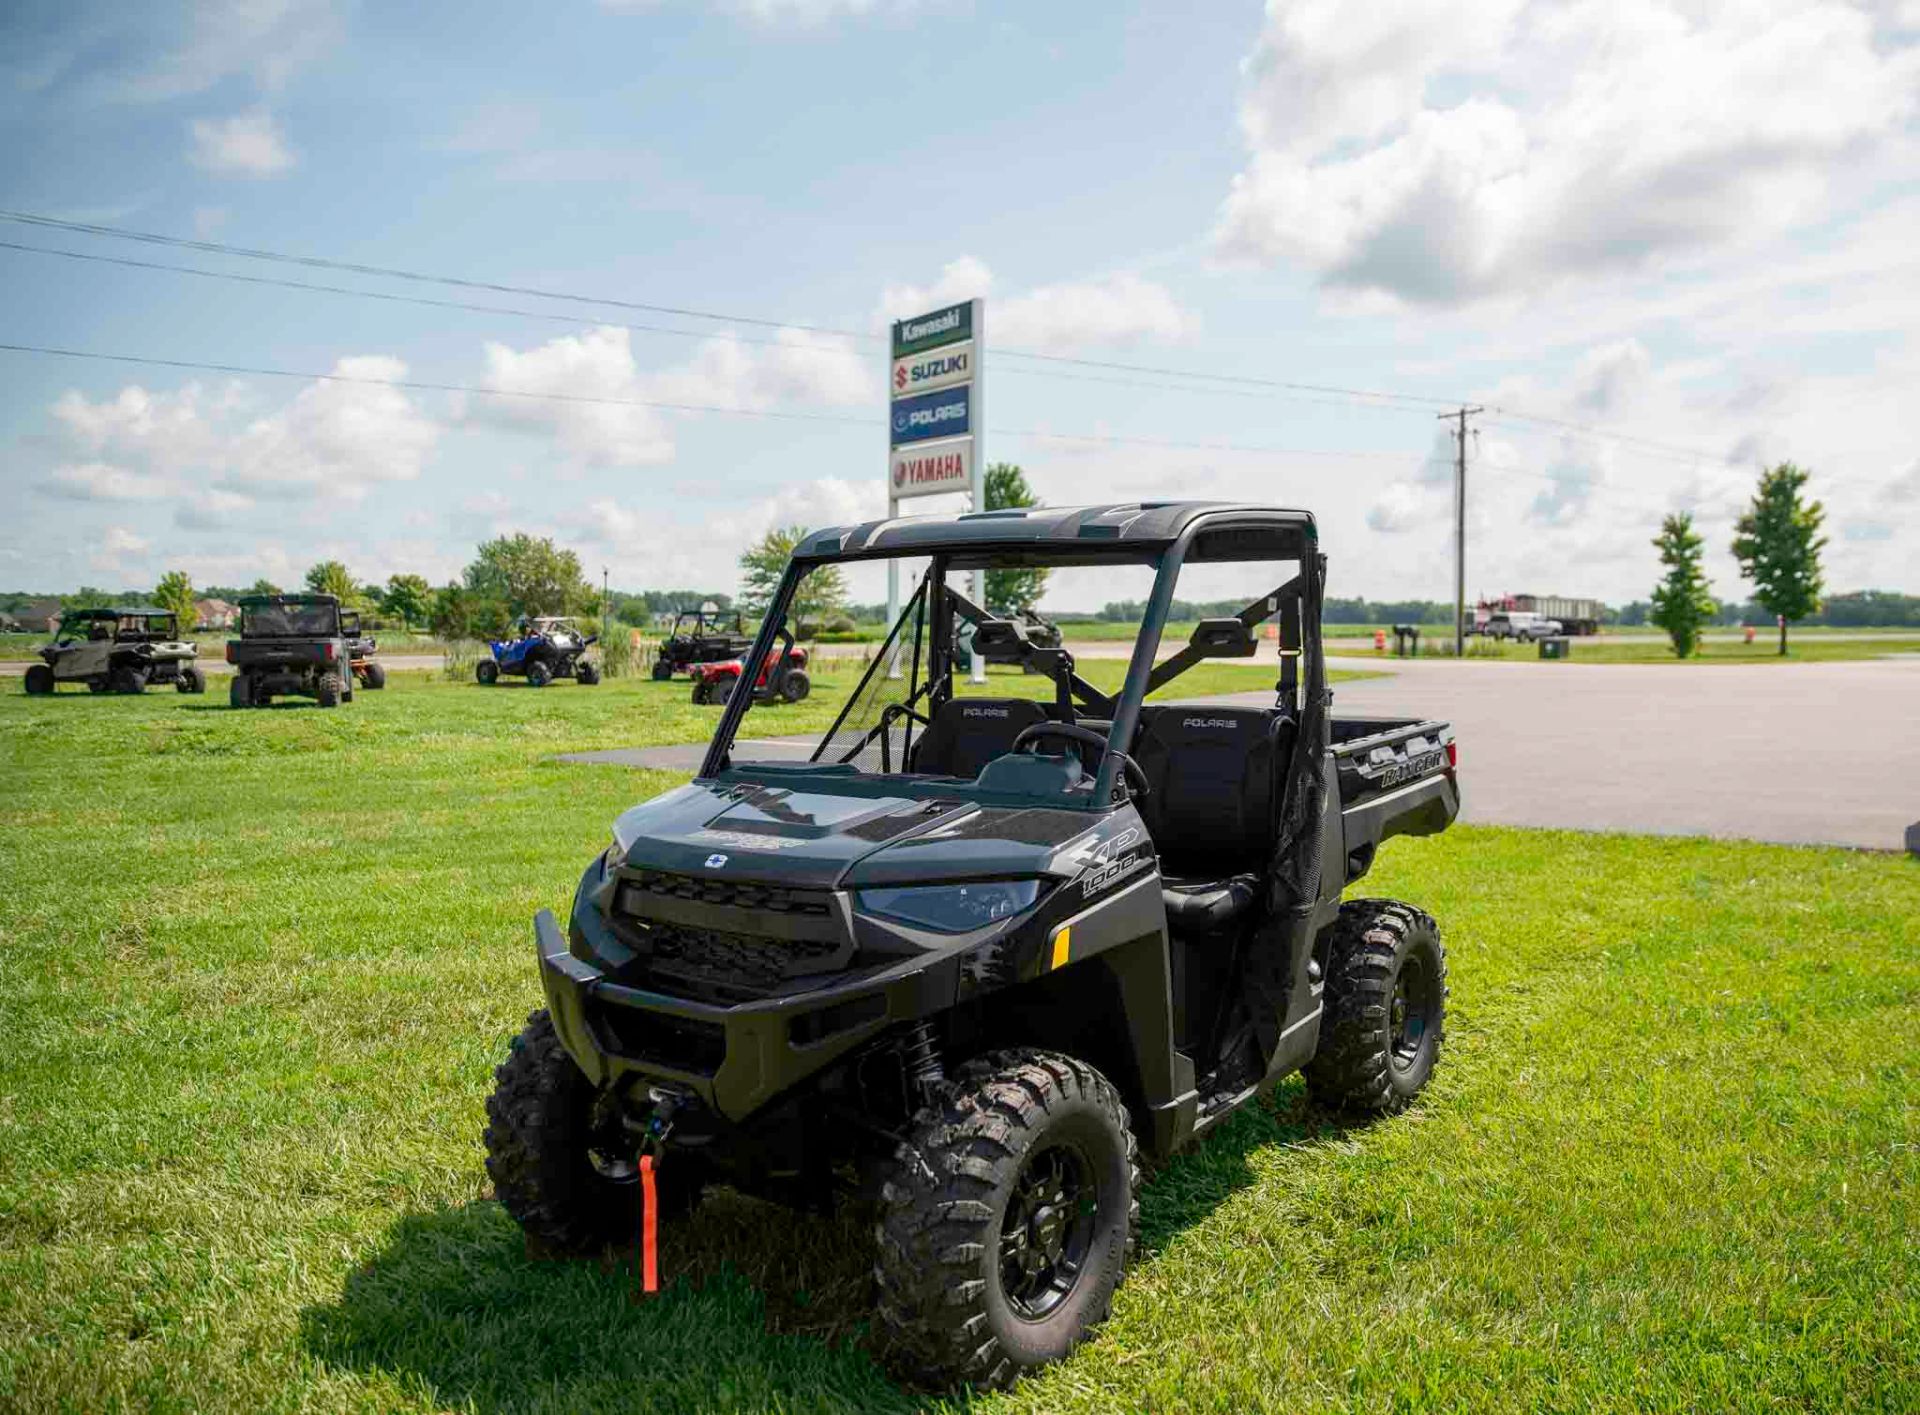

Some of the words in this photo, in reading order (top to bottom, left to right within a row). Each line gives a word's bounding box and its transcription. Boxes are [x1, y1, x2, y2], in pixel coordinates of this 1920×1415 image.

[902, 309, 960, 342] Kawasaki
[911, 354, 968, 382] SUZUKI
[909, 402, 967, 426] POLARIS
[908, 453, 963, 484] YAMAHA
[963, 708, 1009, 718] POLARIS
[1183, 718, 1238, 729] POLARIS
[1083, 853, 1136, 895] 1000
